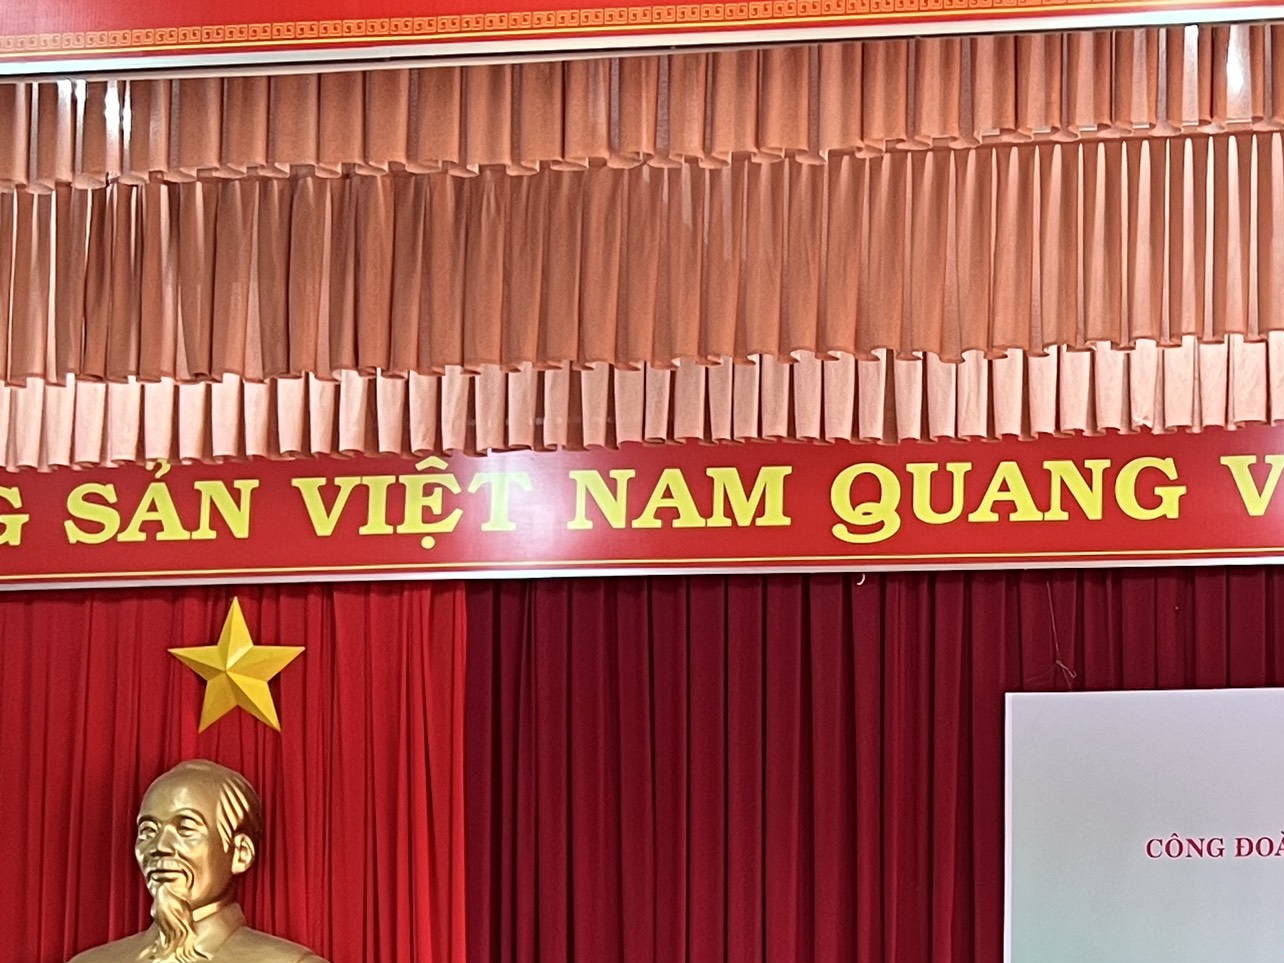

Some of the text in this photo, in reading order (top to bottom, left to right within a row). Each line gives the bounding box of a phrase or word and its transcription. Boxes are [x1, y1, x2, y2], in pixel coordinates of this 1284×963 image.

[63, 458, 260, 544] SẢN
[291, 457, 534, 549] VIỆT
[568, 466, 793, 530] NAM
[830, 457, 1187, 544] QUANG
[1146, 833, 1225, 858] CÔNG
